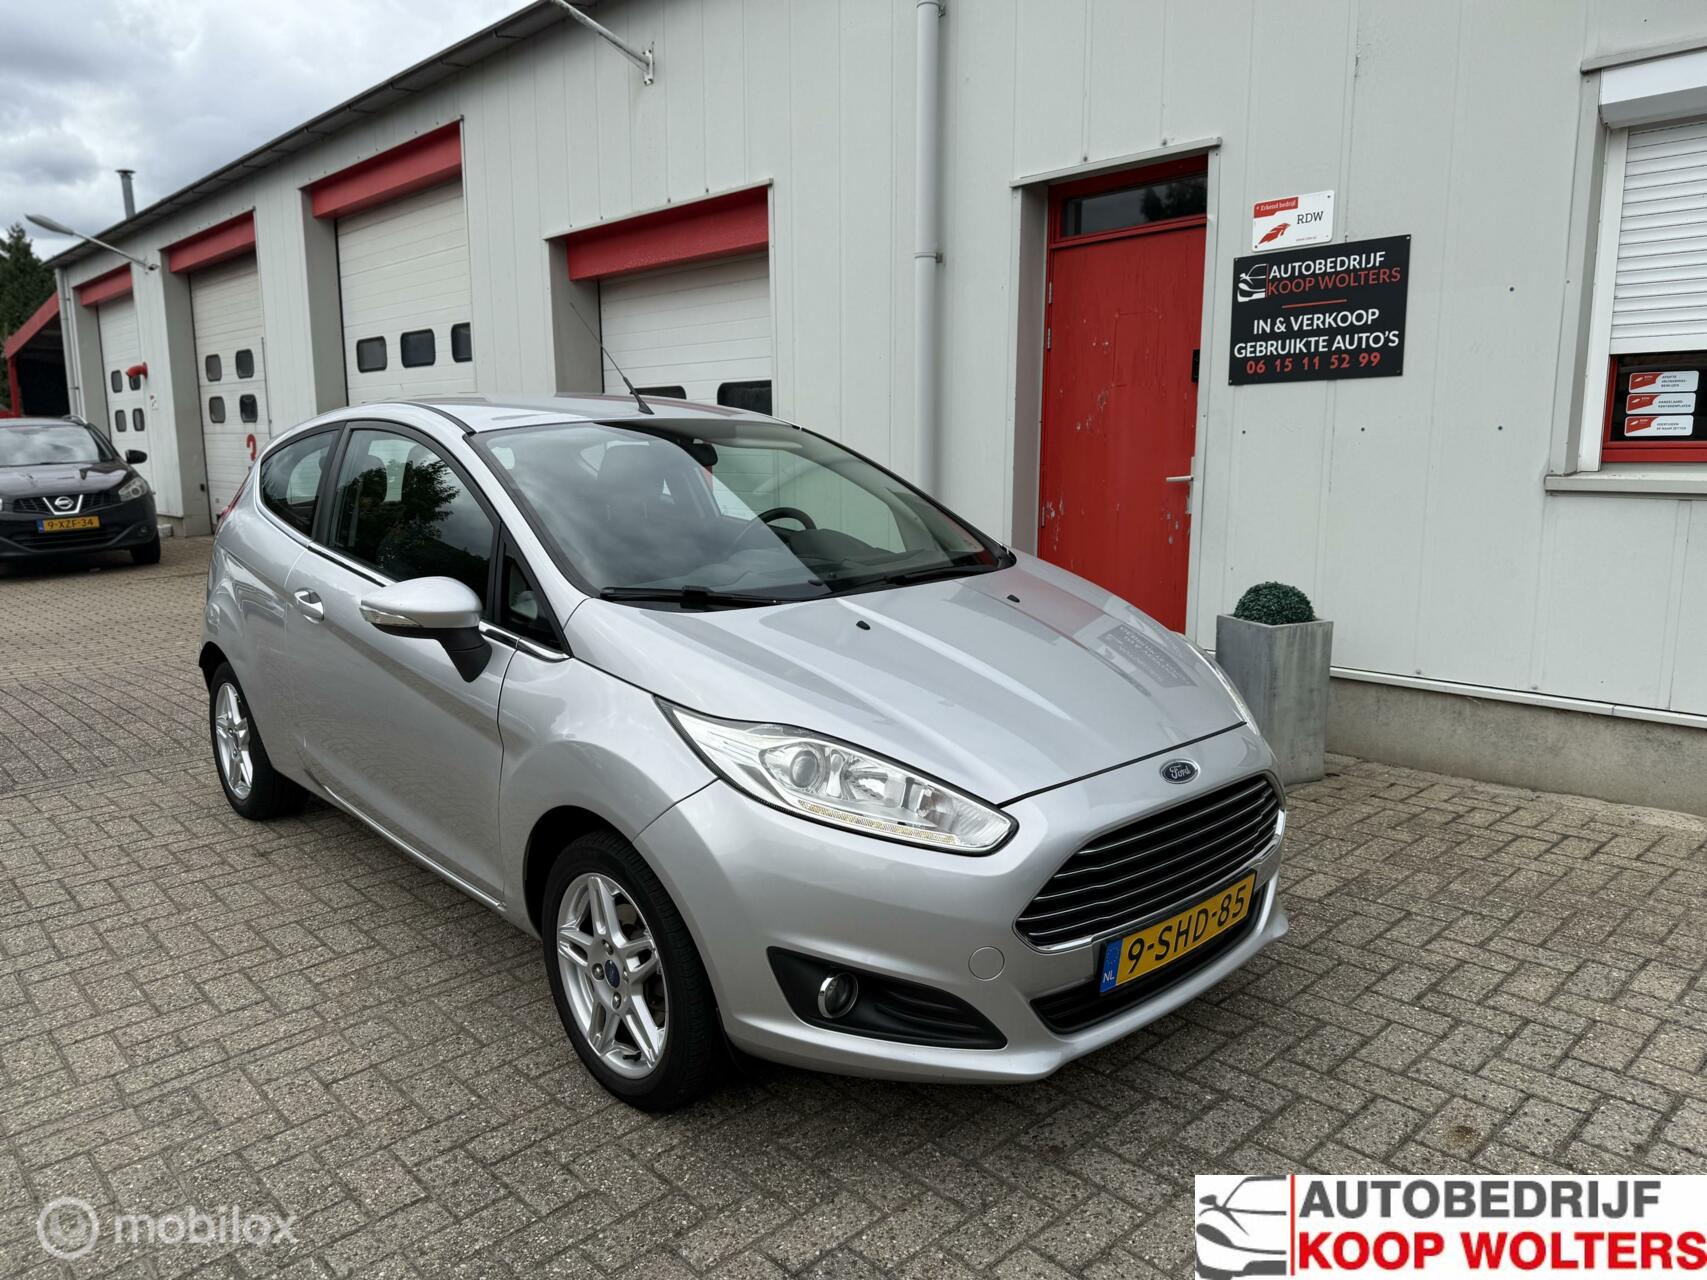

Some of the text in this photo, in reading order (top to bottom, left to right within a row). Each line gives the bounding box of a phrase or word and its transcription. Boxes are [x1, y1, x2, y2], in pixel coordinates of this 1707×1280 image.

[1297, 211, 1324, 225] RDW
[1269, 251, 1386, 279] AUTOBEDRIJF
[1268, 267, 1401, 295] KOOP WOLTERS
[1253, 308, 1380, 335] IN & VERKOOP
[1234, 336, 1329, 358] GEBRUIKTE
[1246, 352, 1381, 374] 06 15 11 52 99
[47, 518, 94, 529] 9-XZF-34
[1169, 764, 1191, 780] Ford
[1127, 883, 1247, 975] 9-SHD-85
[1102, 970, 1115, 983] NL
